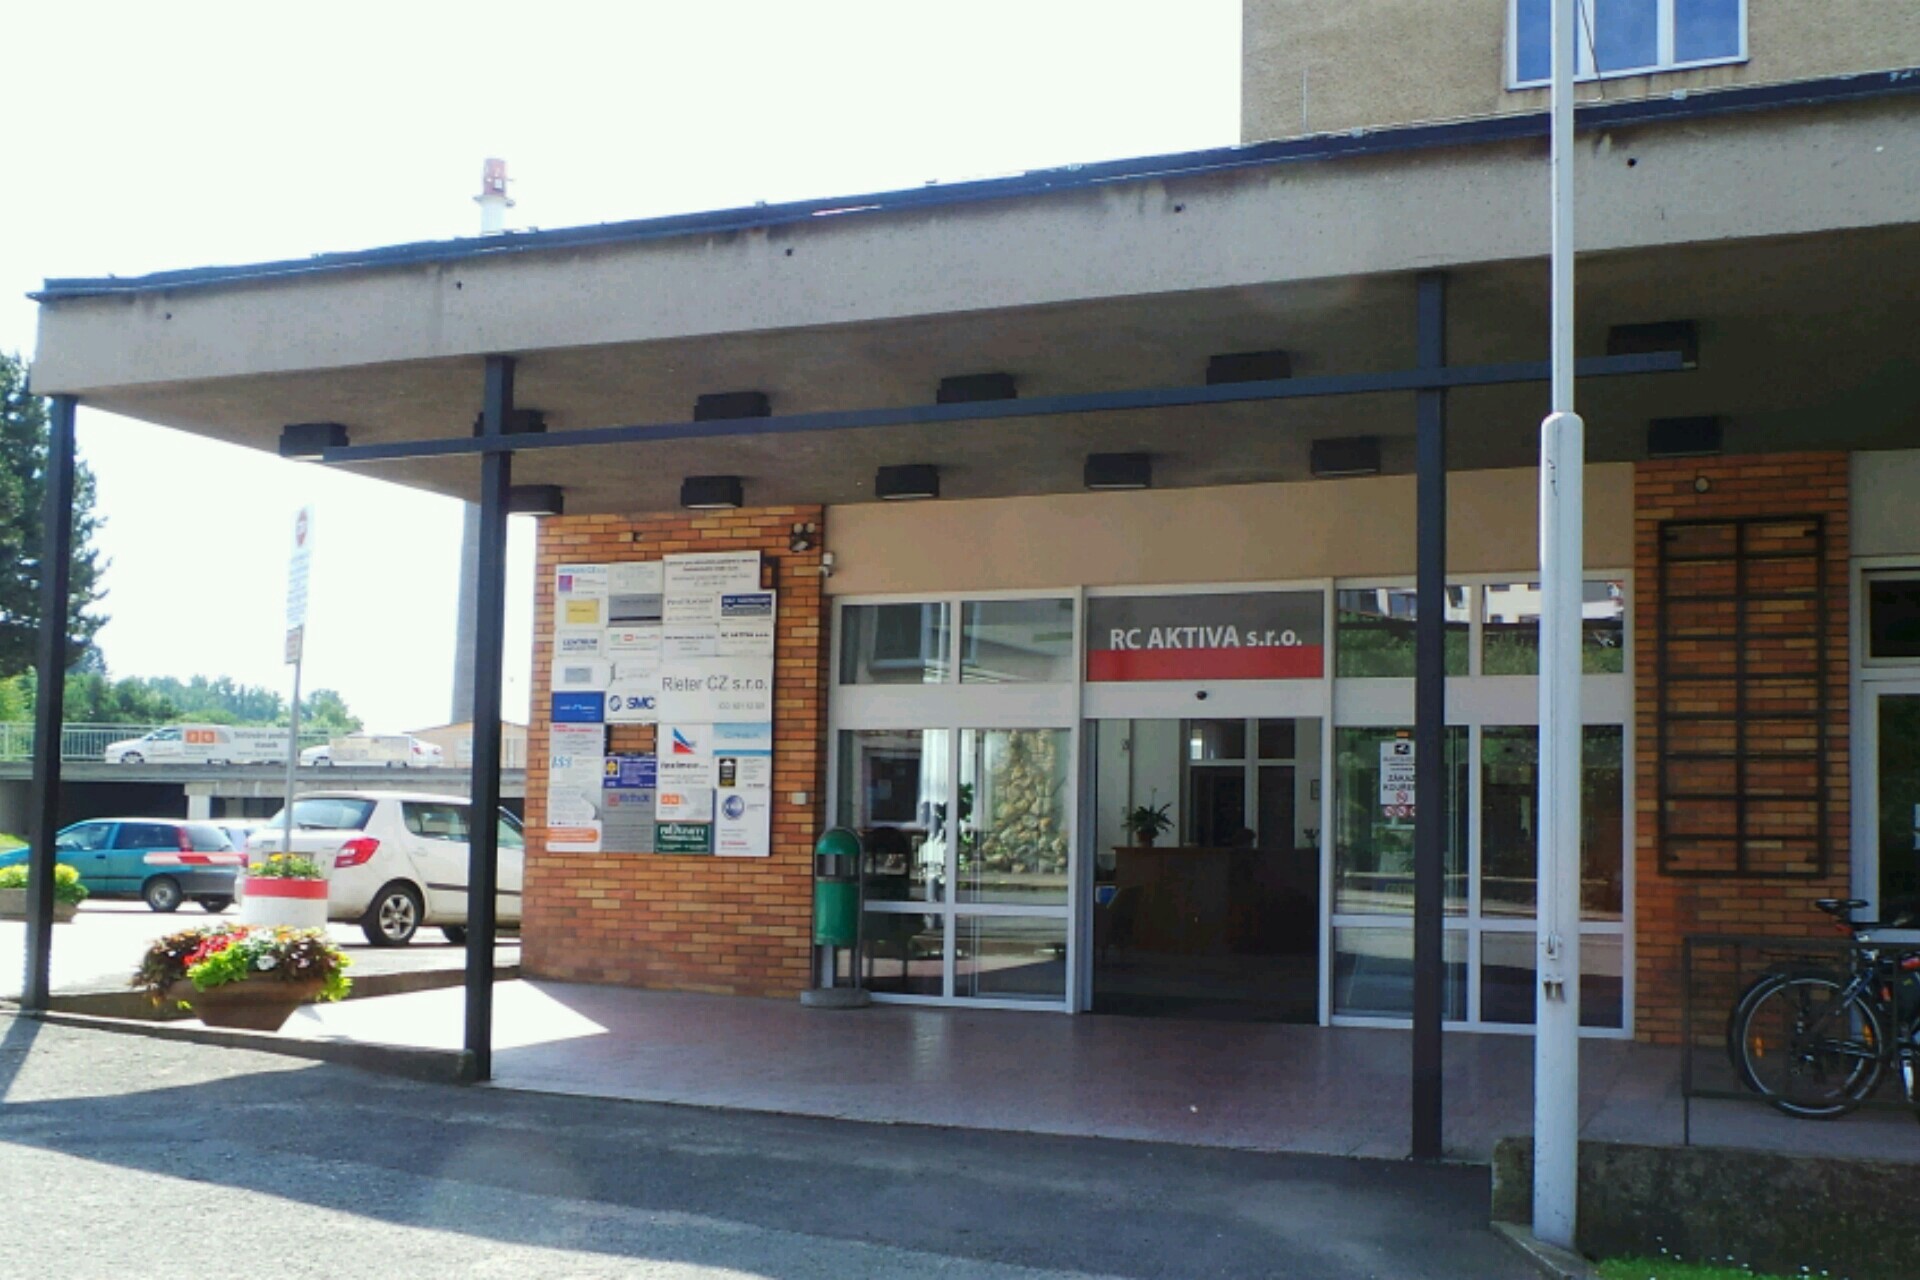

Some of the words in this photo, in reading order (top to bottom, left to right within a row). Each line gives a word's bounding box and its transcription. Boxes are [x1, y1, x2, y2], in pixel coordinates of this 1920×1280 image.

[1110, 629, 1141, 650] RC
[1147, 625, 1240, 649] AKTIVA
[1246, 629, 1303, 647] s.r.o.
[662, 676, 703, 692] Rieter
[707, 674, 728, 691] CZ
[732, 678, 768, 690] s.r.o.
[627, 696, 656, 710] SMC
